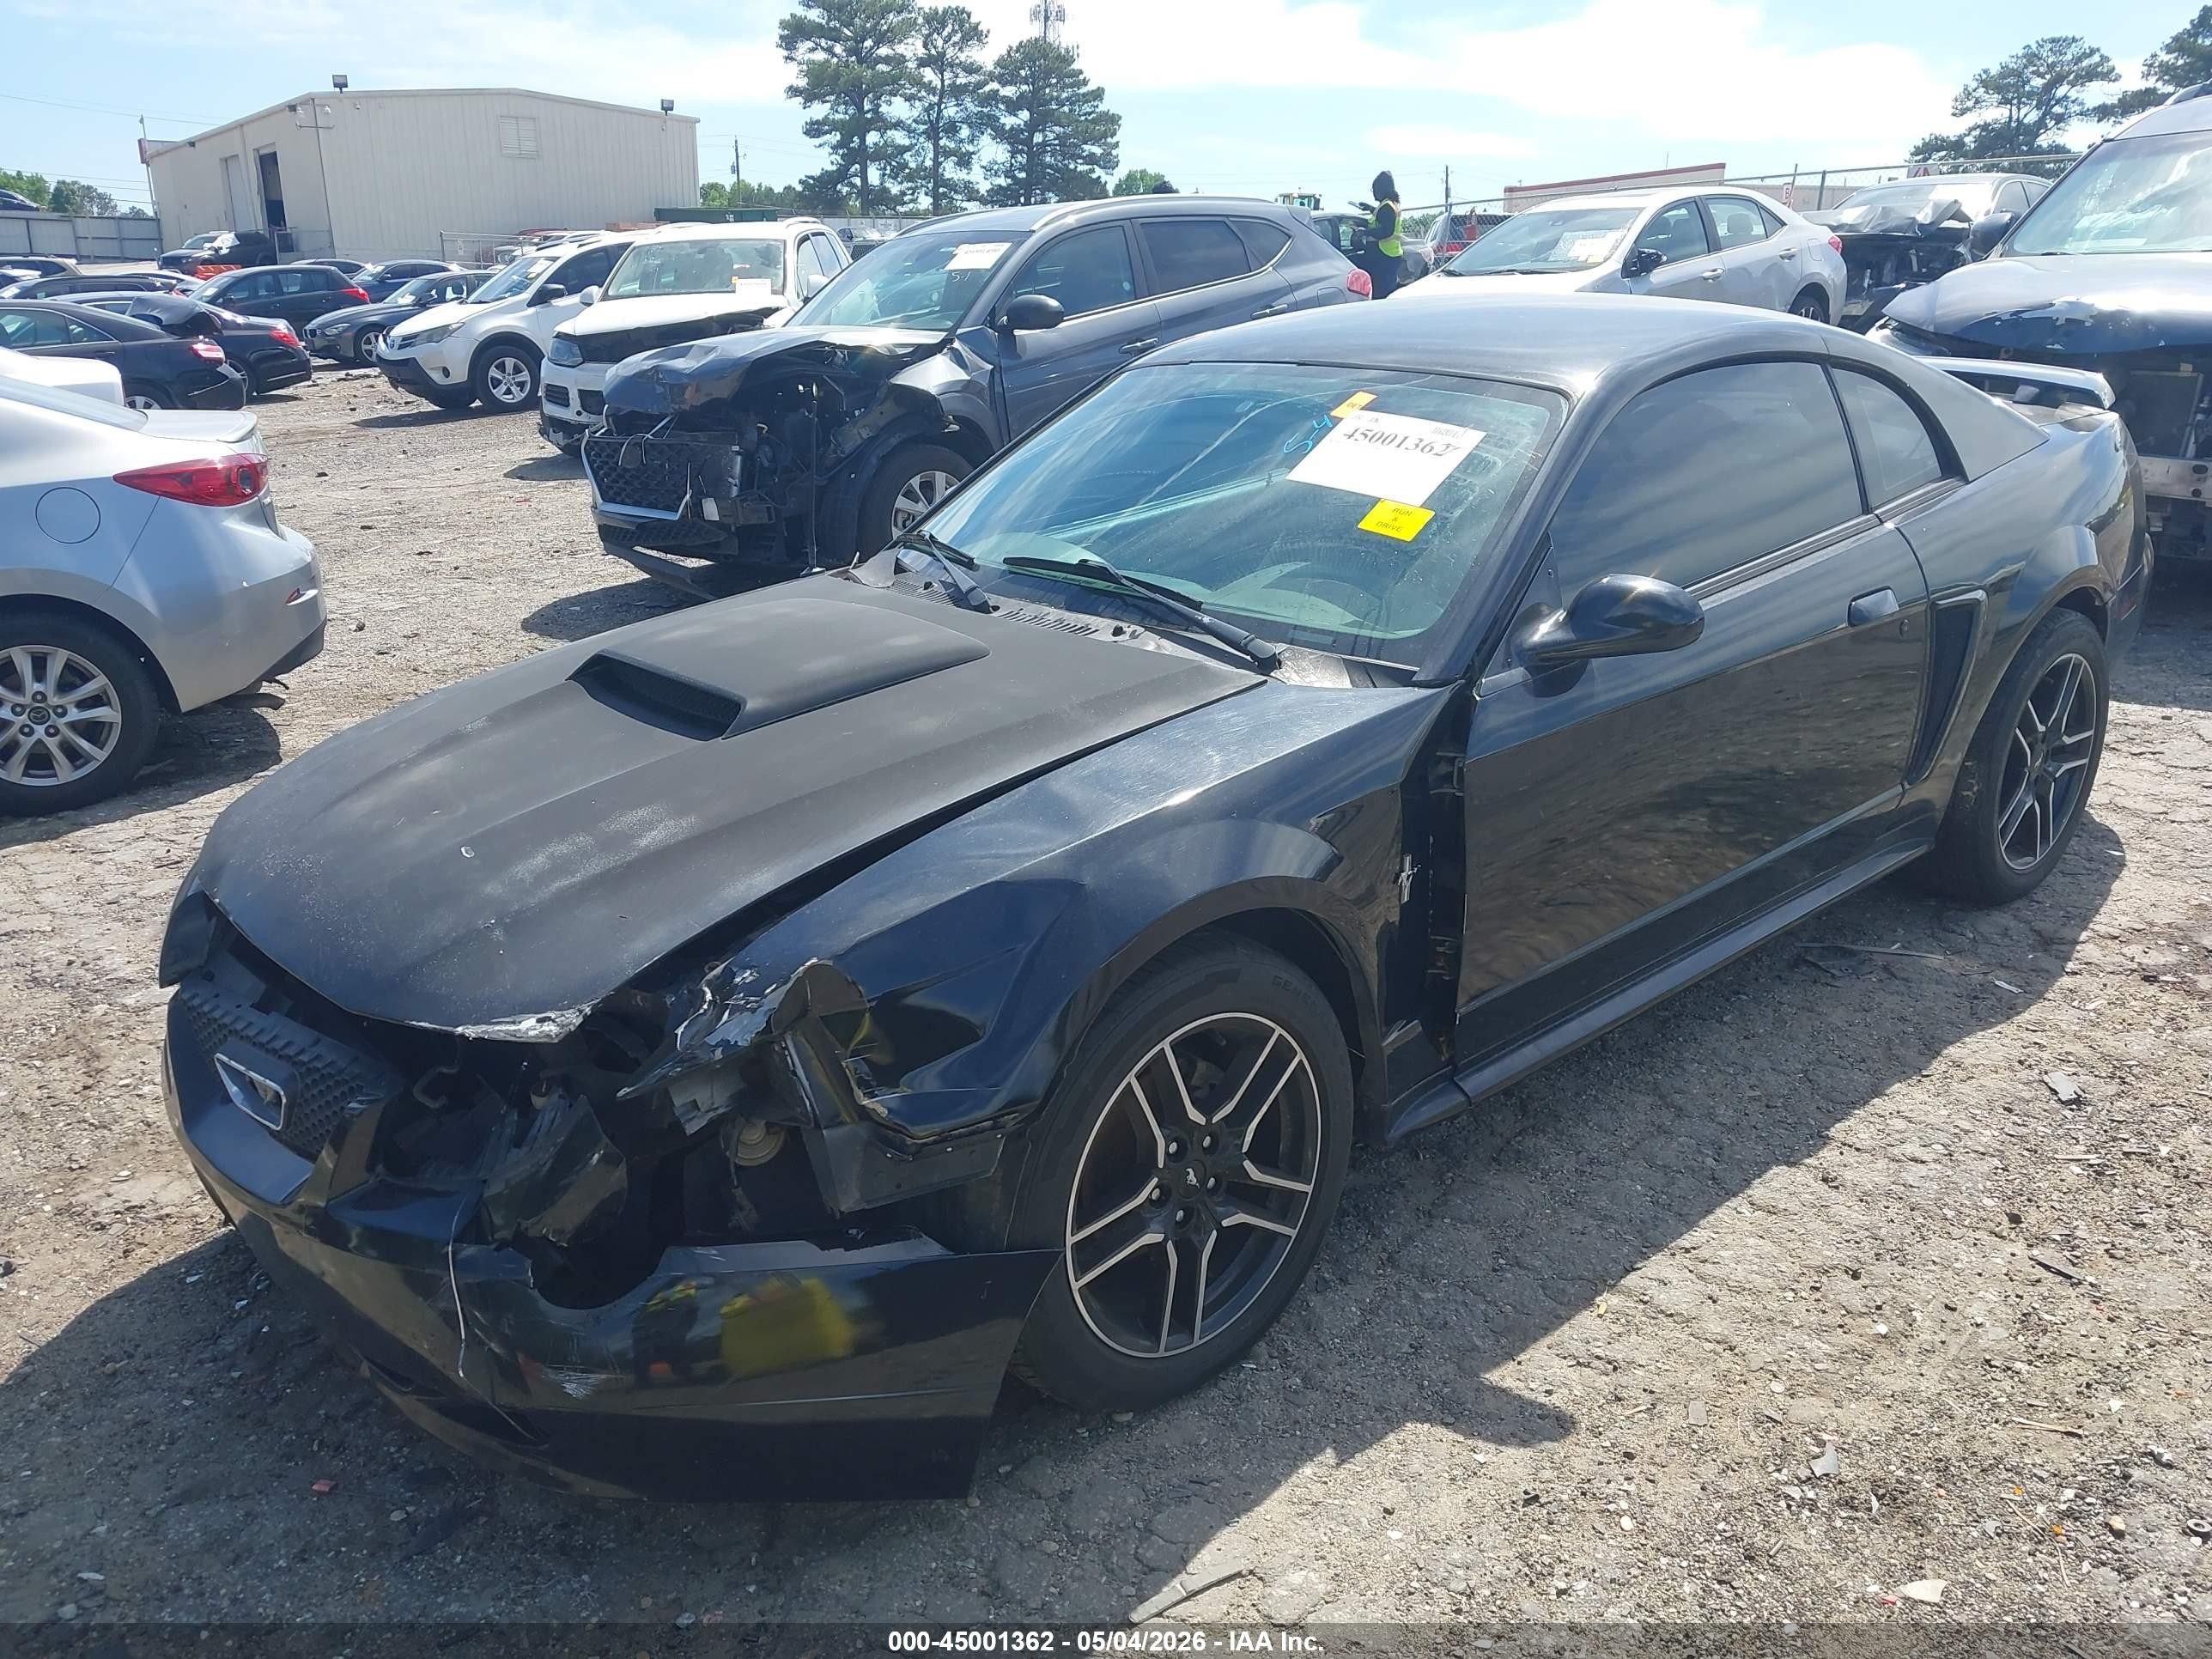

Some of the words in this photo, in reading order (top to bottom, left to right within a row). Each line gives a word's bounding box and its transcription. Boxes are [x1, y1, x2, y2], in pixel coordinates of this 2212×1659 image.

[1343, 426, 1460, 457] 45001362
[1391, 507, 1413, 517] RUN
[1376, 520, 1404, 532] DRIVE
